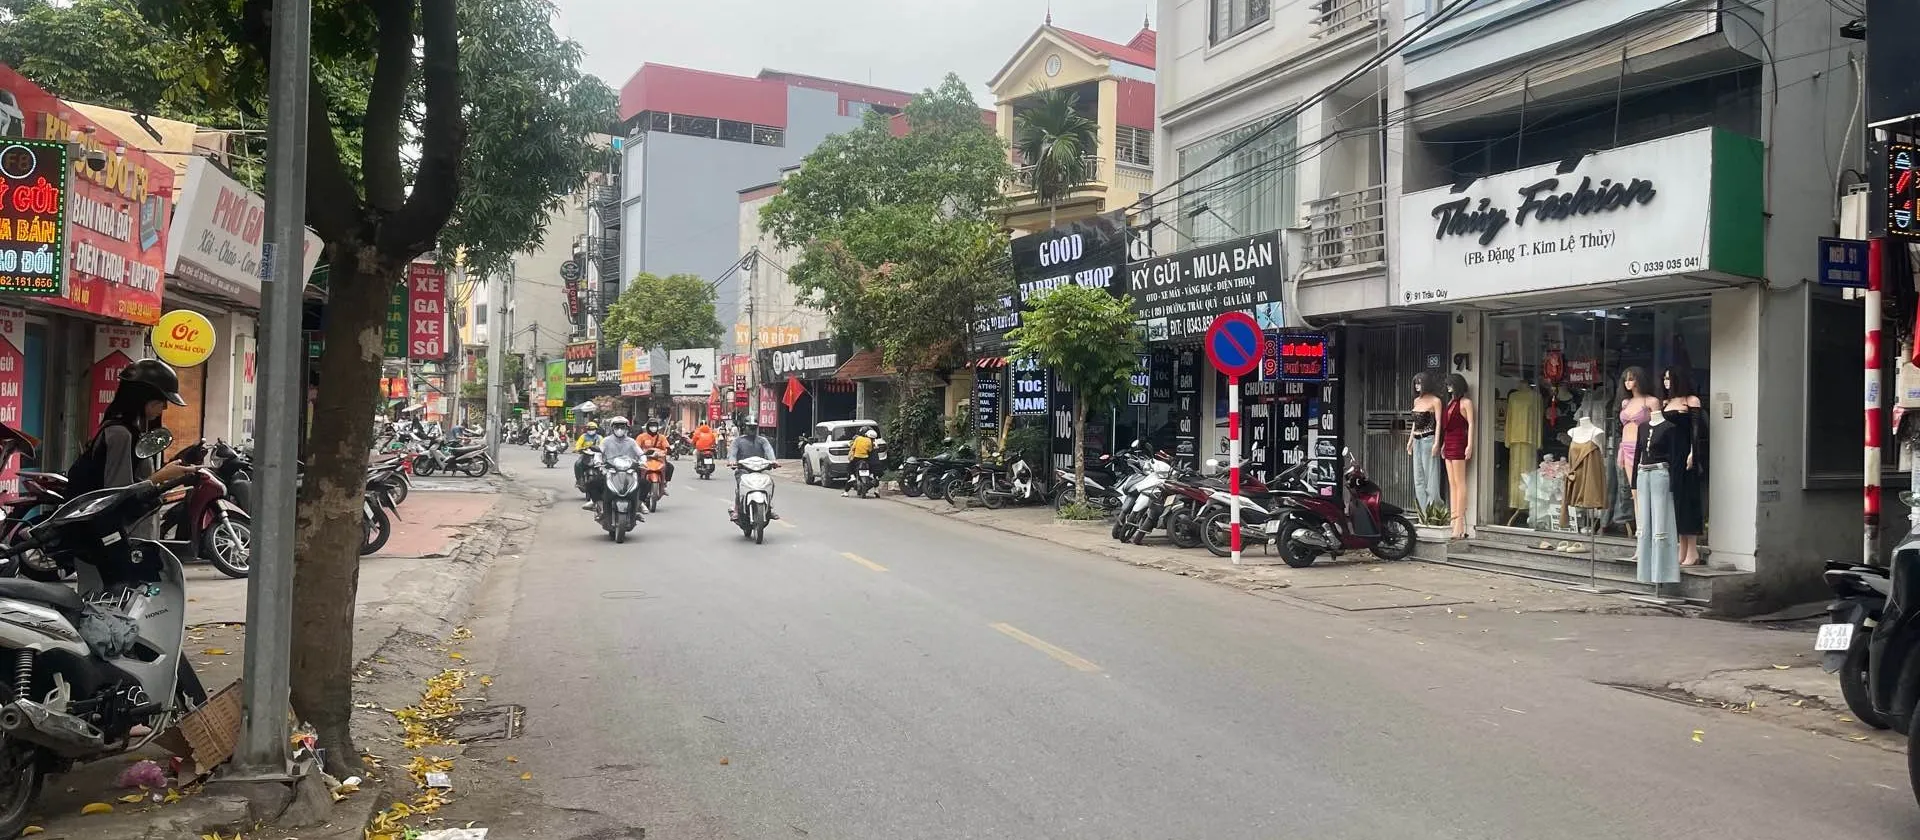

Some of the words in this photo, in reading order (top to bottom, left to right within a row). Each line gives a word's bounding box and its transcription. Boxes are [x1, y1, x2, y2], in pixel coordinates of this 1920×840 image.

[212, 186, 248, 236] PHỞ
[1515, 176, 1656, 226] Fashion
[17, 215, 55, 244] BÁN
[1039, 234, 1083, 267] GOOD
[1487, 247, 1515, 266] Đặng
[1532, 240, 1556, 255] Kim
[1560, 236, 1575, 253] Lệ
[1131, 263, 1150, 291] KÝ
[1153, 258, 1181, 286] GỬI
[1193, 251, 1231, 279] MUA
[1233, 238, 1273, 272] BÁN
[1643, 261, 1664, 273] 0339
[1666, 259, 1682, 271] 035
[1684, 257, 1700, 268] 041
[416, 278, 439, 293] XE
[1075, 266, 1114, 290] SHOP
[414, 298, 439, 314] GA
[171, 319, 199, 342] Ốc
[415, 319, 439, 335] XE
[413, 336, 439, 356] SỐ
[783, 350, 804, 372] DOG
[1453, 352, 1472, 372] 91
[1, 379, 18, 397] BÁN
[1323, 384, 1332, 403] KÝ
[1014, 397, 1045, 411] NAM
[1251, 404, 1269, 418] MUA
[1283, 401, 1301, 418] BÁN
[1055, 404, 1072, 439] TÓC
[1254, 423, 1265, 440] KÝ
[1284, 422, 1300, 441] GỬI
